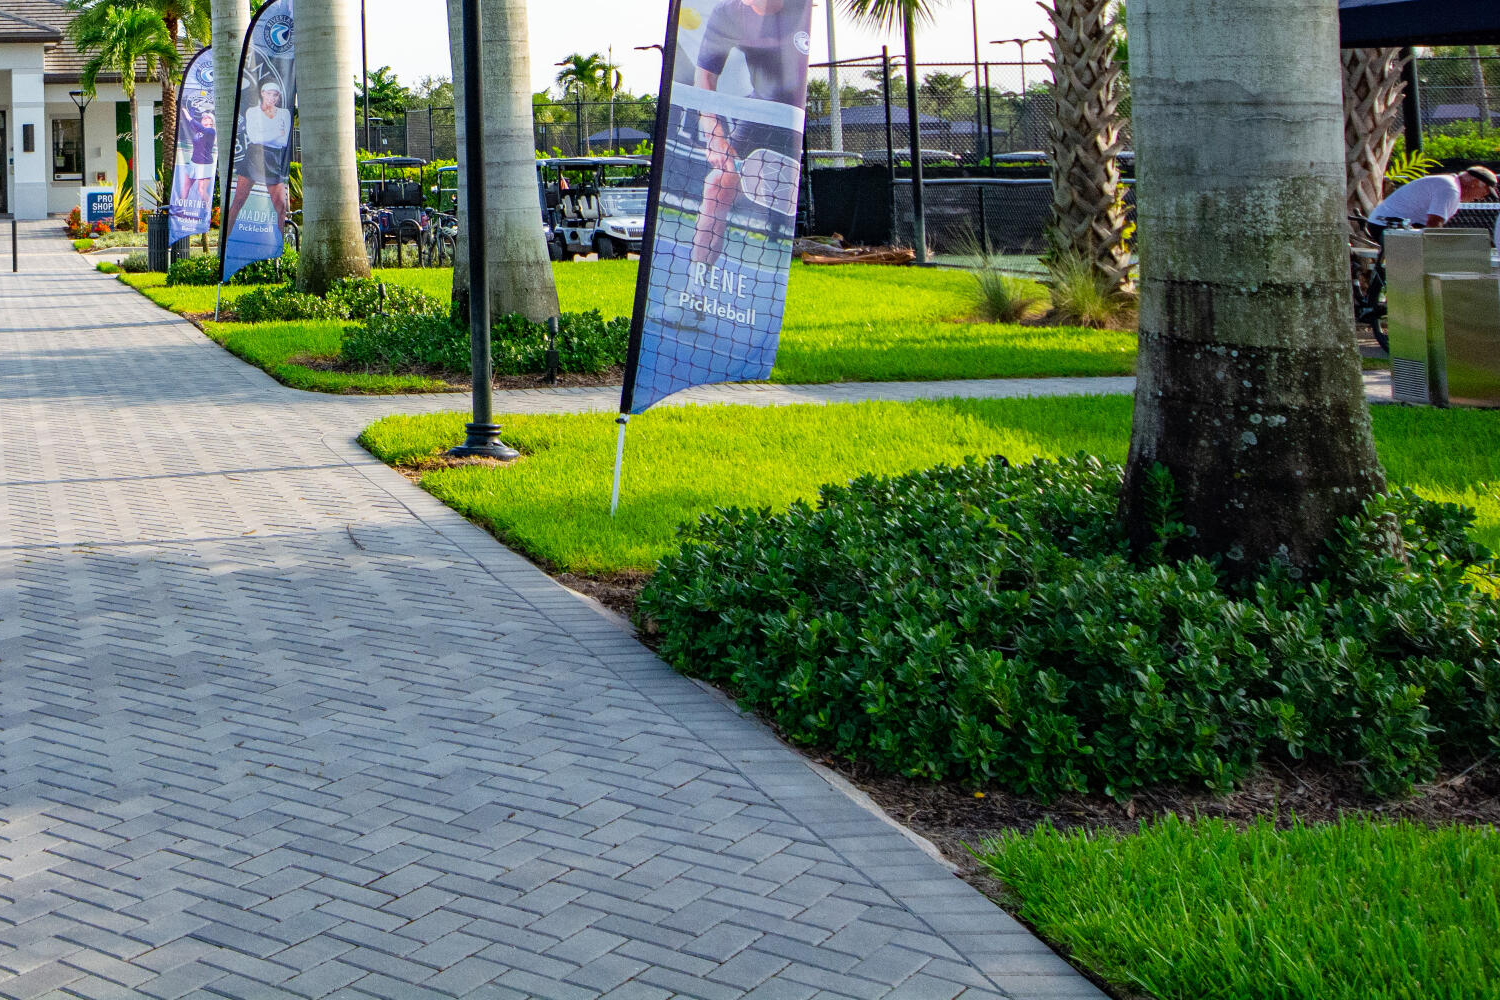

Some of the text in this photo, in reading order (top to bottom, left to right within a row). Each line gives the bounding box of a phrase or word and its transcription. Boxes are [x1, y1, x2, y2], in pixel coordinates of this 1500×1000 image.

[97, 194, 113, 203] PRO
[92, 202, 113, 211] SHOP
[238, 209, 277, 223] MADDIE
[238, 223, 274, 234] Pickleball
[694, 261, 748, 299] RENE
[678, 291, 756, 326] Pickleball
